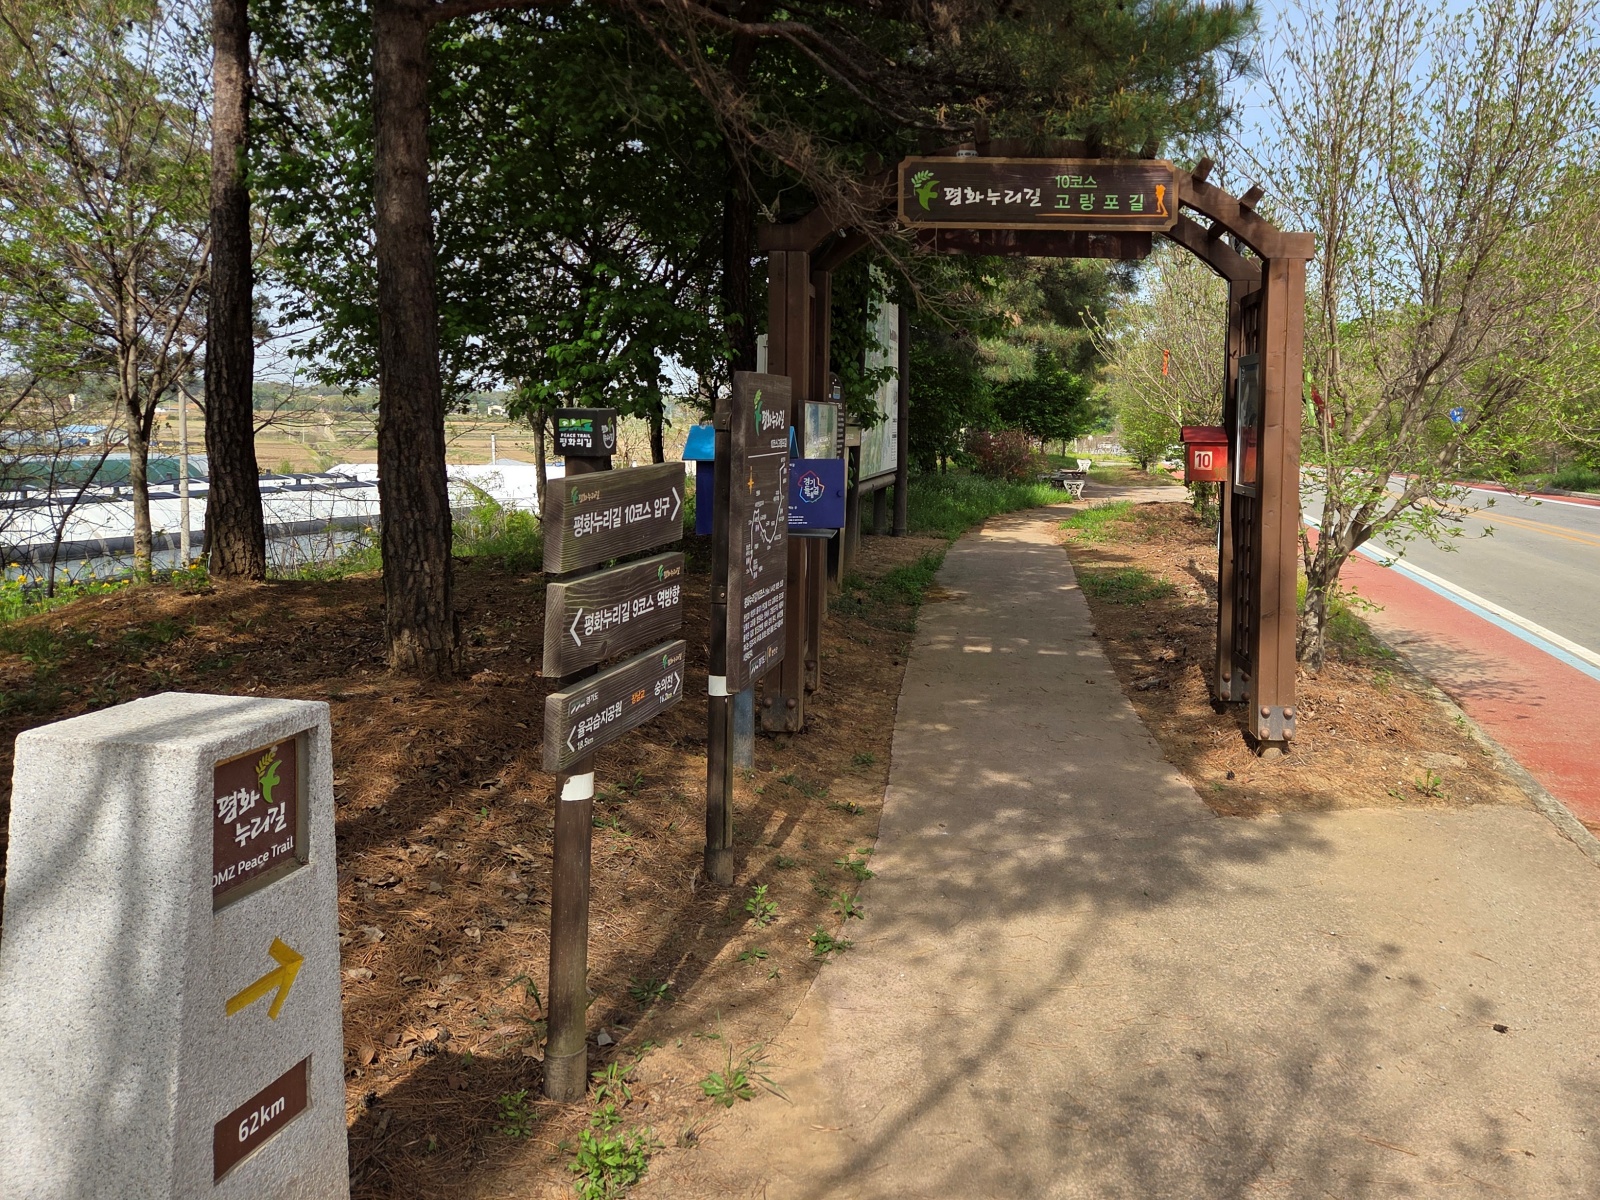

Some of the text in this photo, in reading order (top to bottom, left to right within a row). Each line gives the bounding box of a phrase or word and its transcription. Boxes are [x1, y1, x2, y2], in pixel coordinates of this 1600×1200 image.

[944, 187, 1042, 208] 평화누리길
[1055, 174, 1098, 190] 10코스
[761, 409, 785, 431] 평화누리길
[559, 438, 592, 448] 평화의길
[1195, 453, 1211, 468] 10
[573, 496, 671, 537] 평화누리길 10코스 입구
[584, 584, 680, 636] 평화누리길 9코스 역방향
[585, 691, 599, 705] 경기도
[653, 672, 674, 696] 숭의전
[577, 700, 623, 739] 율곡습지공원
[216, 787, 260, 825] 평화
[234, 801, 287, 848] 누리길
[237, 851, 269, 876] Peace
[270, 835, 294, 858] Trail
[238, 1096, 285, 1143] 62km
